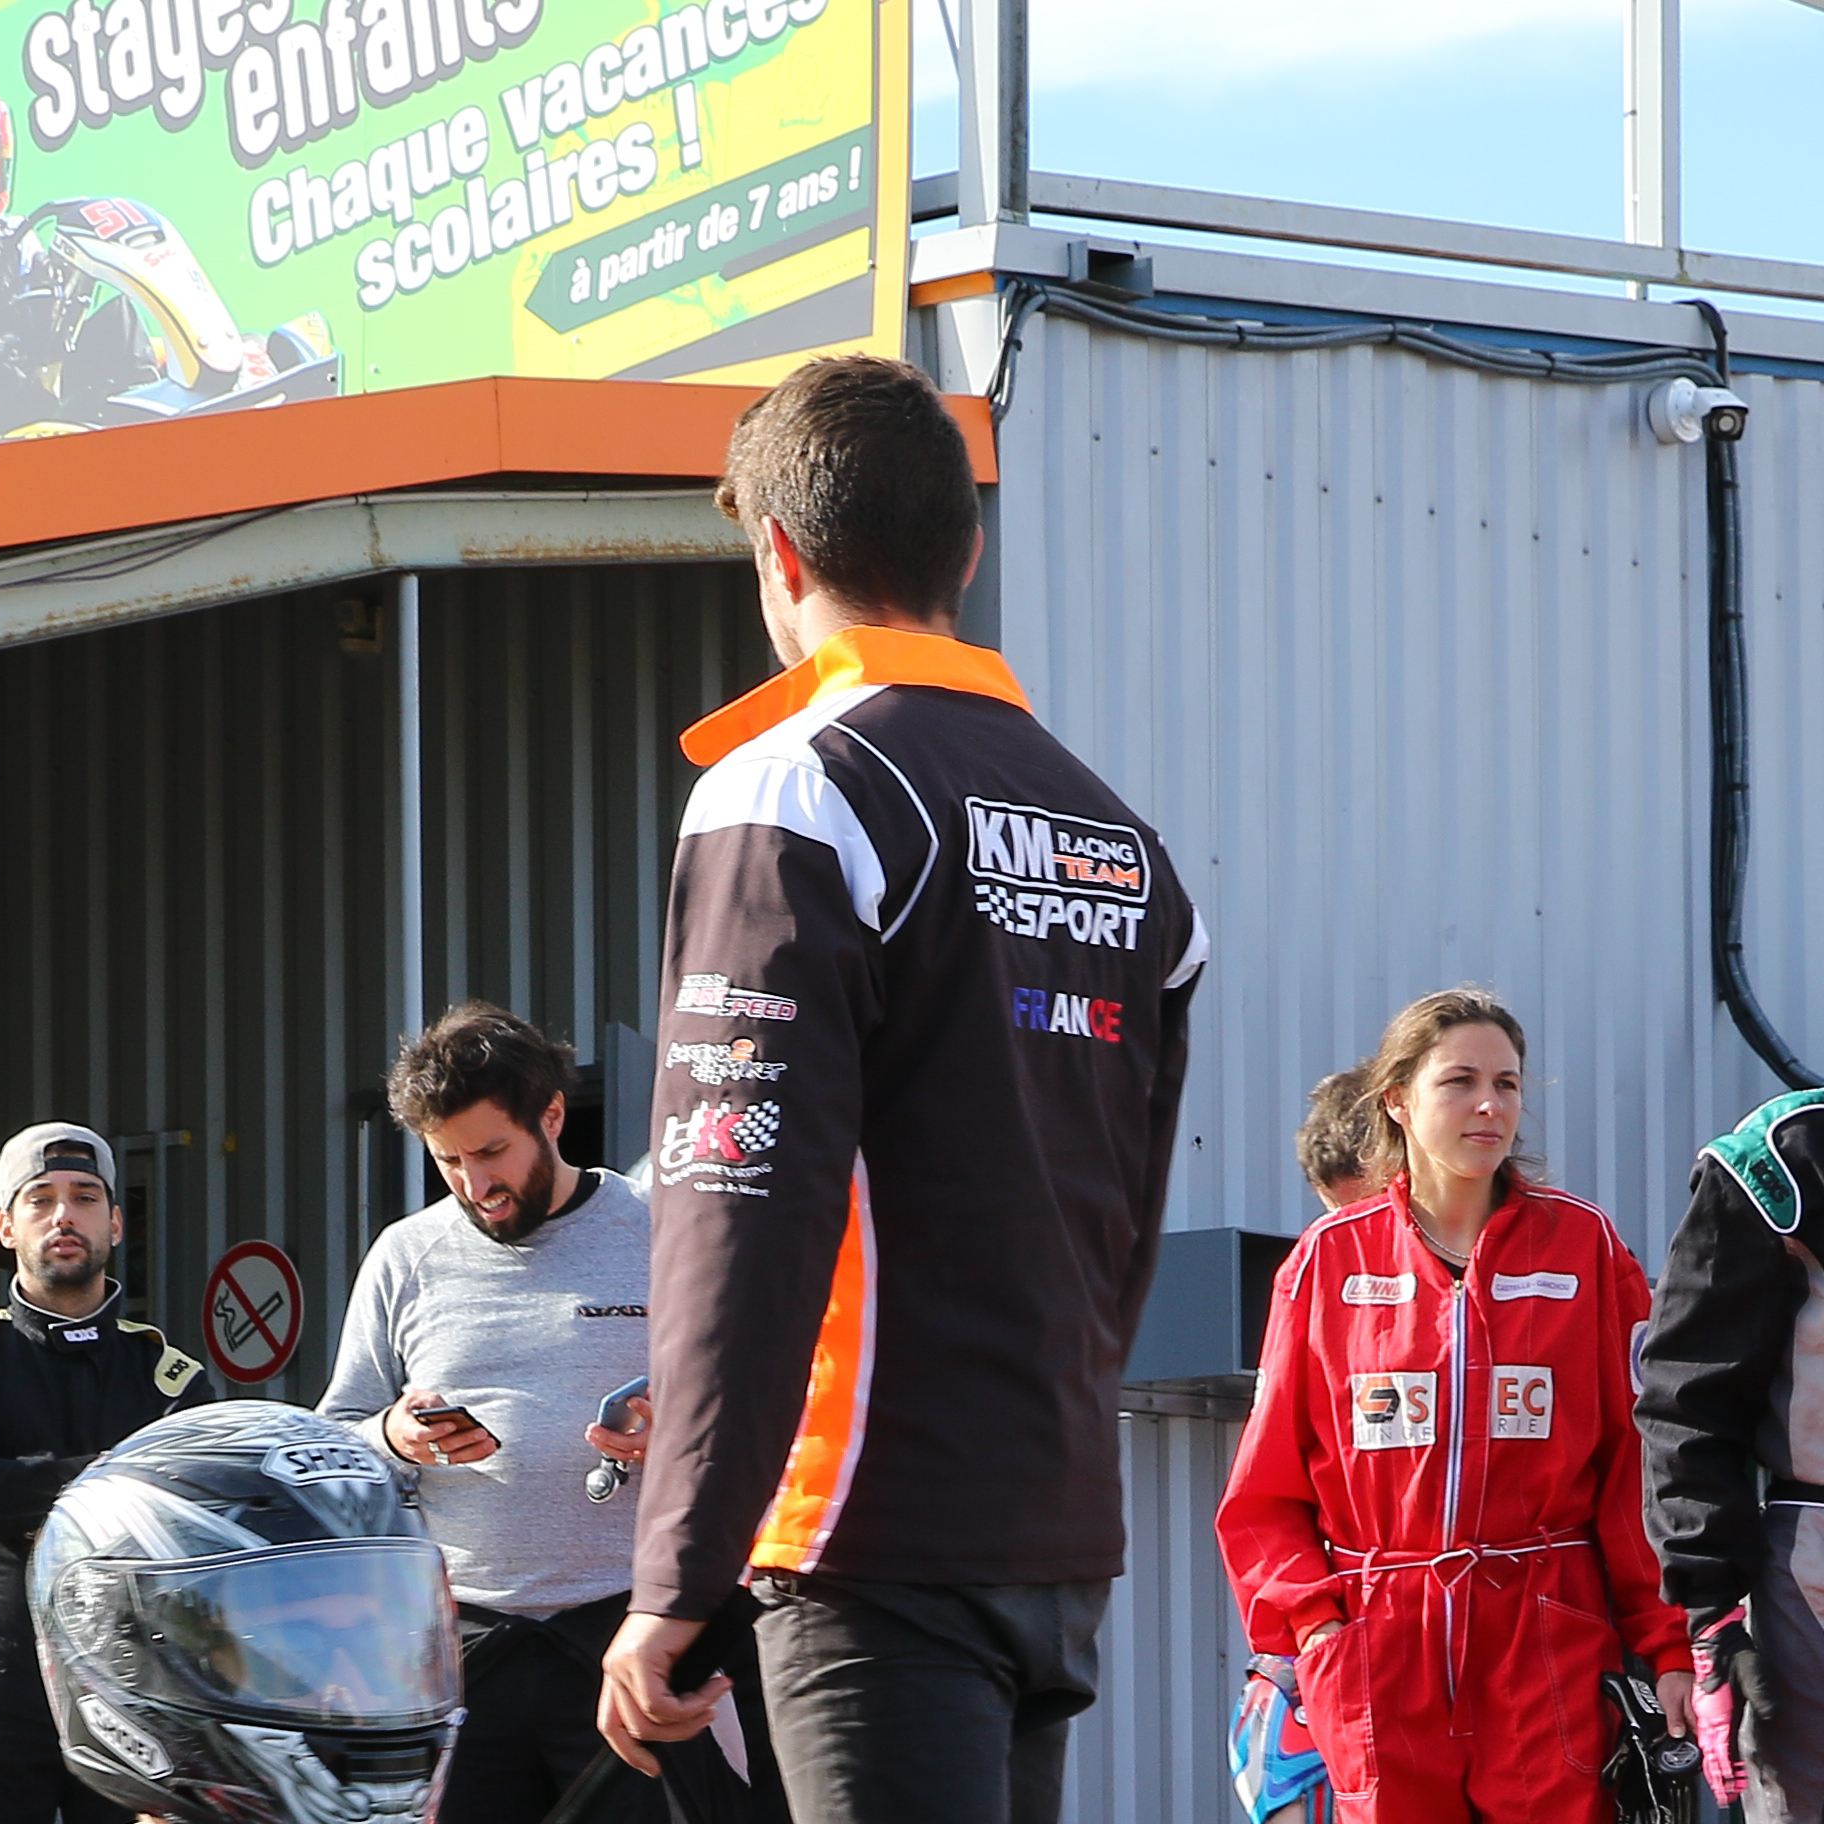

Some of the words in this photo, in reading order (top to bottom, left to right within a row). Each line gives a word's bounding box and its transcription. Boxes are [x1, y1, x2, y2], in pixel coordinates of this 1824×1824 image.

[250, 107, 488, 264] Chaque
[356, 122, 658, 309] scolaires
[675, 81, 702, 170] !
[570, 257, 591, 303] à
[599, 221, 691, 299] partir
[697, 203, 740, 251] de
[749, 184, 771, 230] 7
[776, 166, 840, 220] ans
[972, 806, 1058, 882] KM
[1057, 831, 1136, 865] RACING
[1053, 854, 1141, 890] TEAM
[1015, 892, 1146, 951] SPORT
[1012, 986, 1123, 1043] FRANCE
